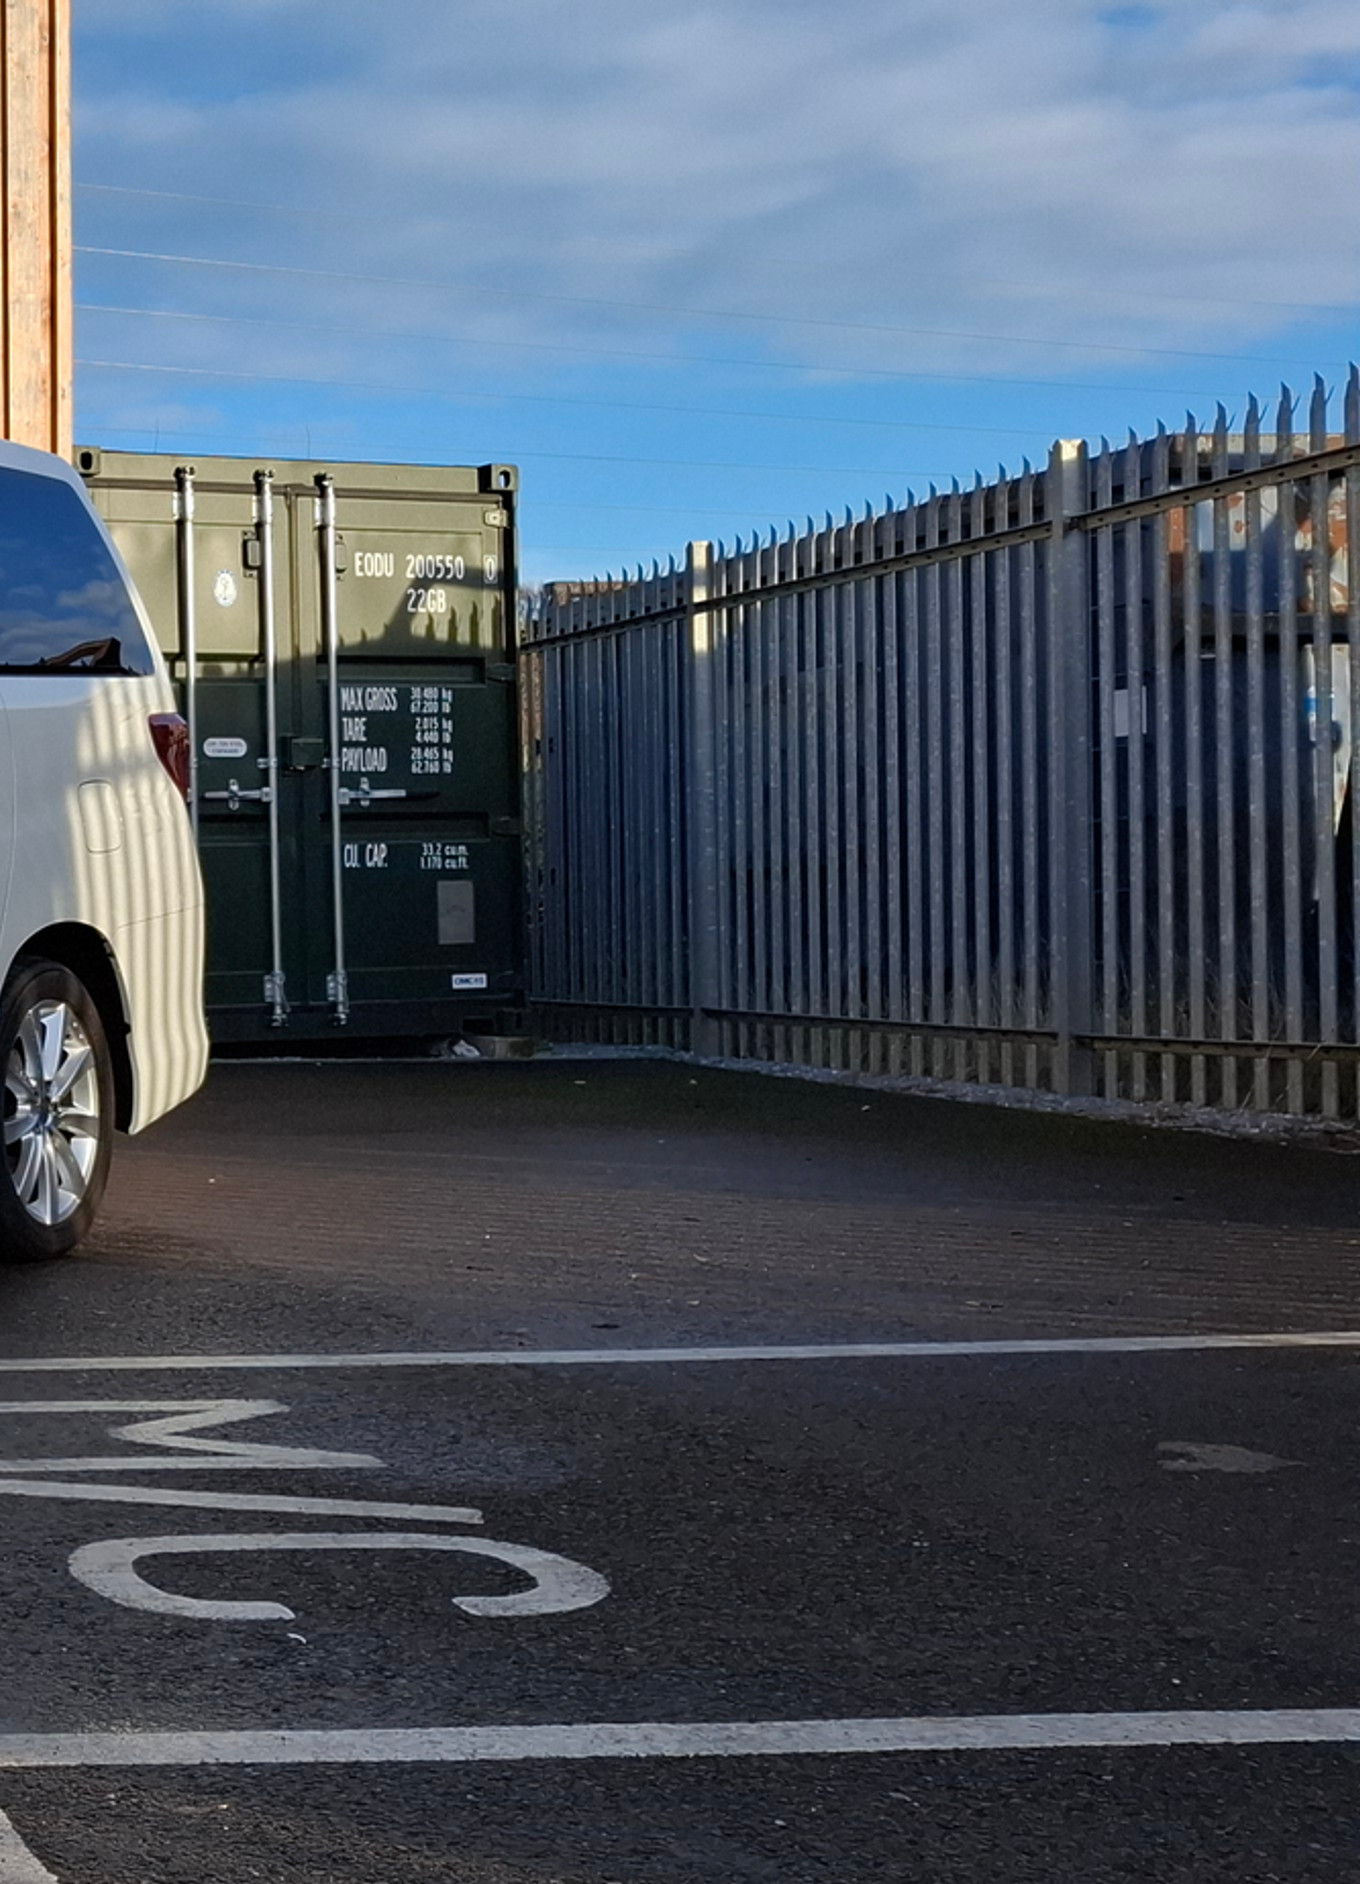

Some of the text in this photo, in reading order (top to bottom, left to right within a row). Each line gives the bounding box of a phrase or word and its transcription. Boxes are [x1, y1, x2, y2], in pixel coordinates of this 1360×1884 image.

[354, 552, 395, 577] EODU
[405, 554, 465, 579] 200550
[407, 588, 447, 613] 22GB
[341, 687, 364, 711] MAX
[365, 686, 398, 711] GROSS
[442, 687, 453, 703] kg
[442, 701, 451, 713] lb
[342, 717, 367, 741] TARE
[442, 717, 453, 733] kg
[442, 731, 451, 743] lb
[341, 746, 388, 772] PAYLOAD
[442, 747, 453, 763] kg
[442, 761, 452, 774] lb
[365, 843, 388, 868] CAP.
[421, 842, 441, 855] 33.2
